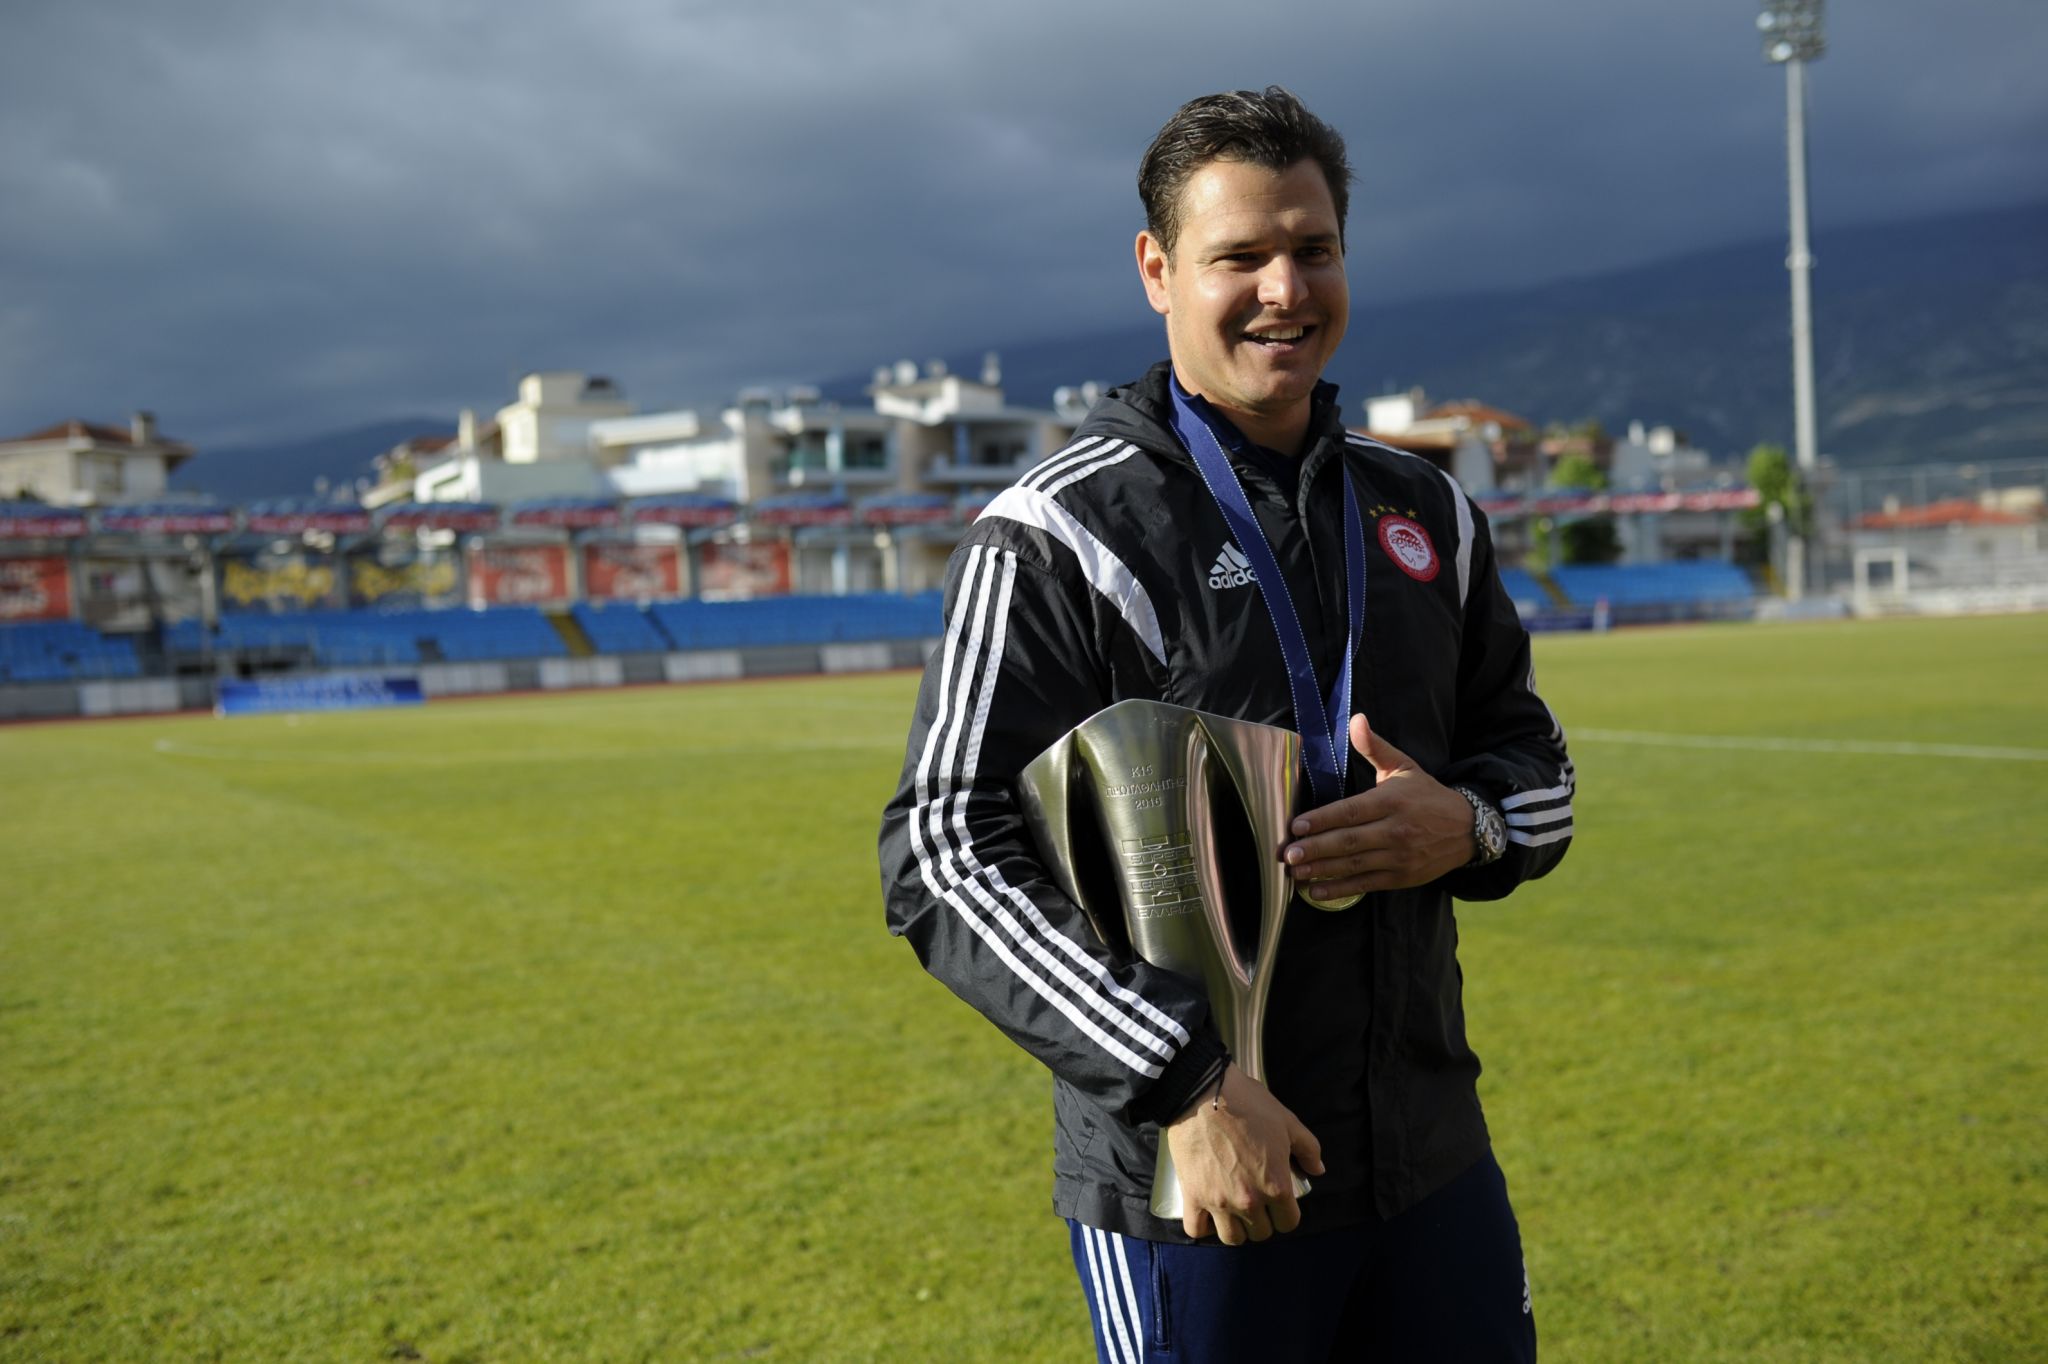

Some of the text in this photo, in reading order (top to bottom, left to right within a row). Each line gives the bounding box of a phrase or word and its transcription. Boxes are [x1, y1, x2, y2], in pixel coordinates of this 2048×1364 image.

[1208, 569, 1257, 589] adida
[1131, 850, 1188, 864] SUPER
[1131, 874, 1198, 891] LEAGUE
